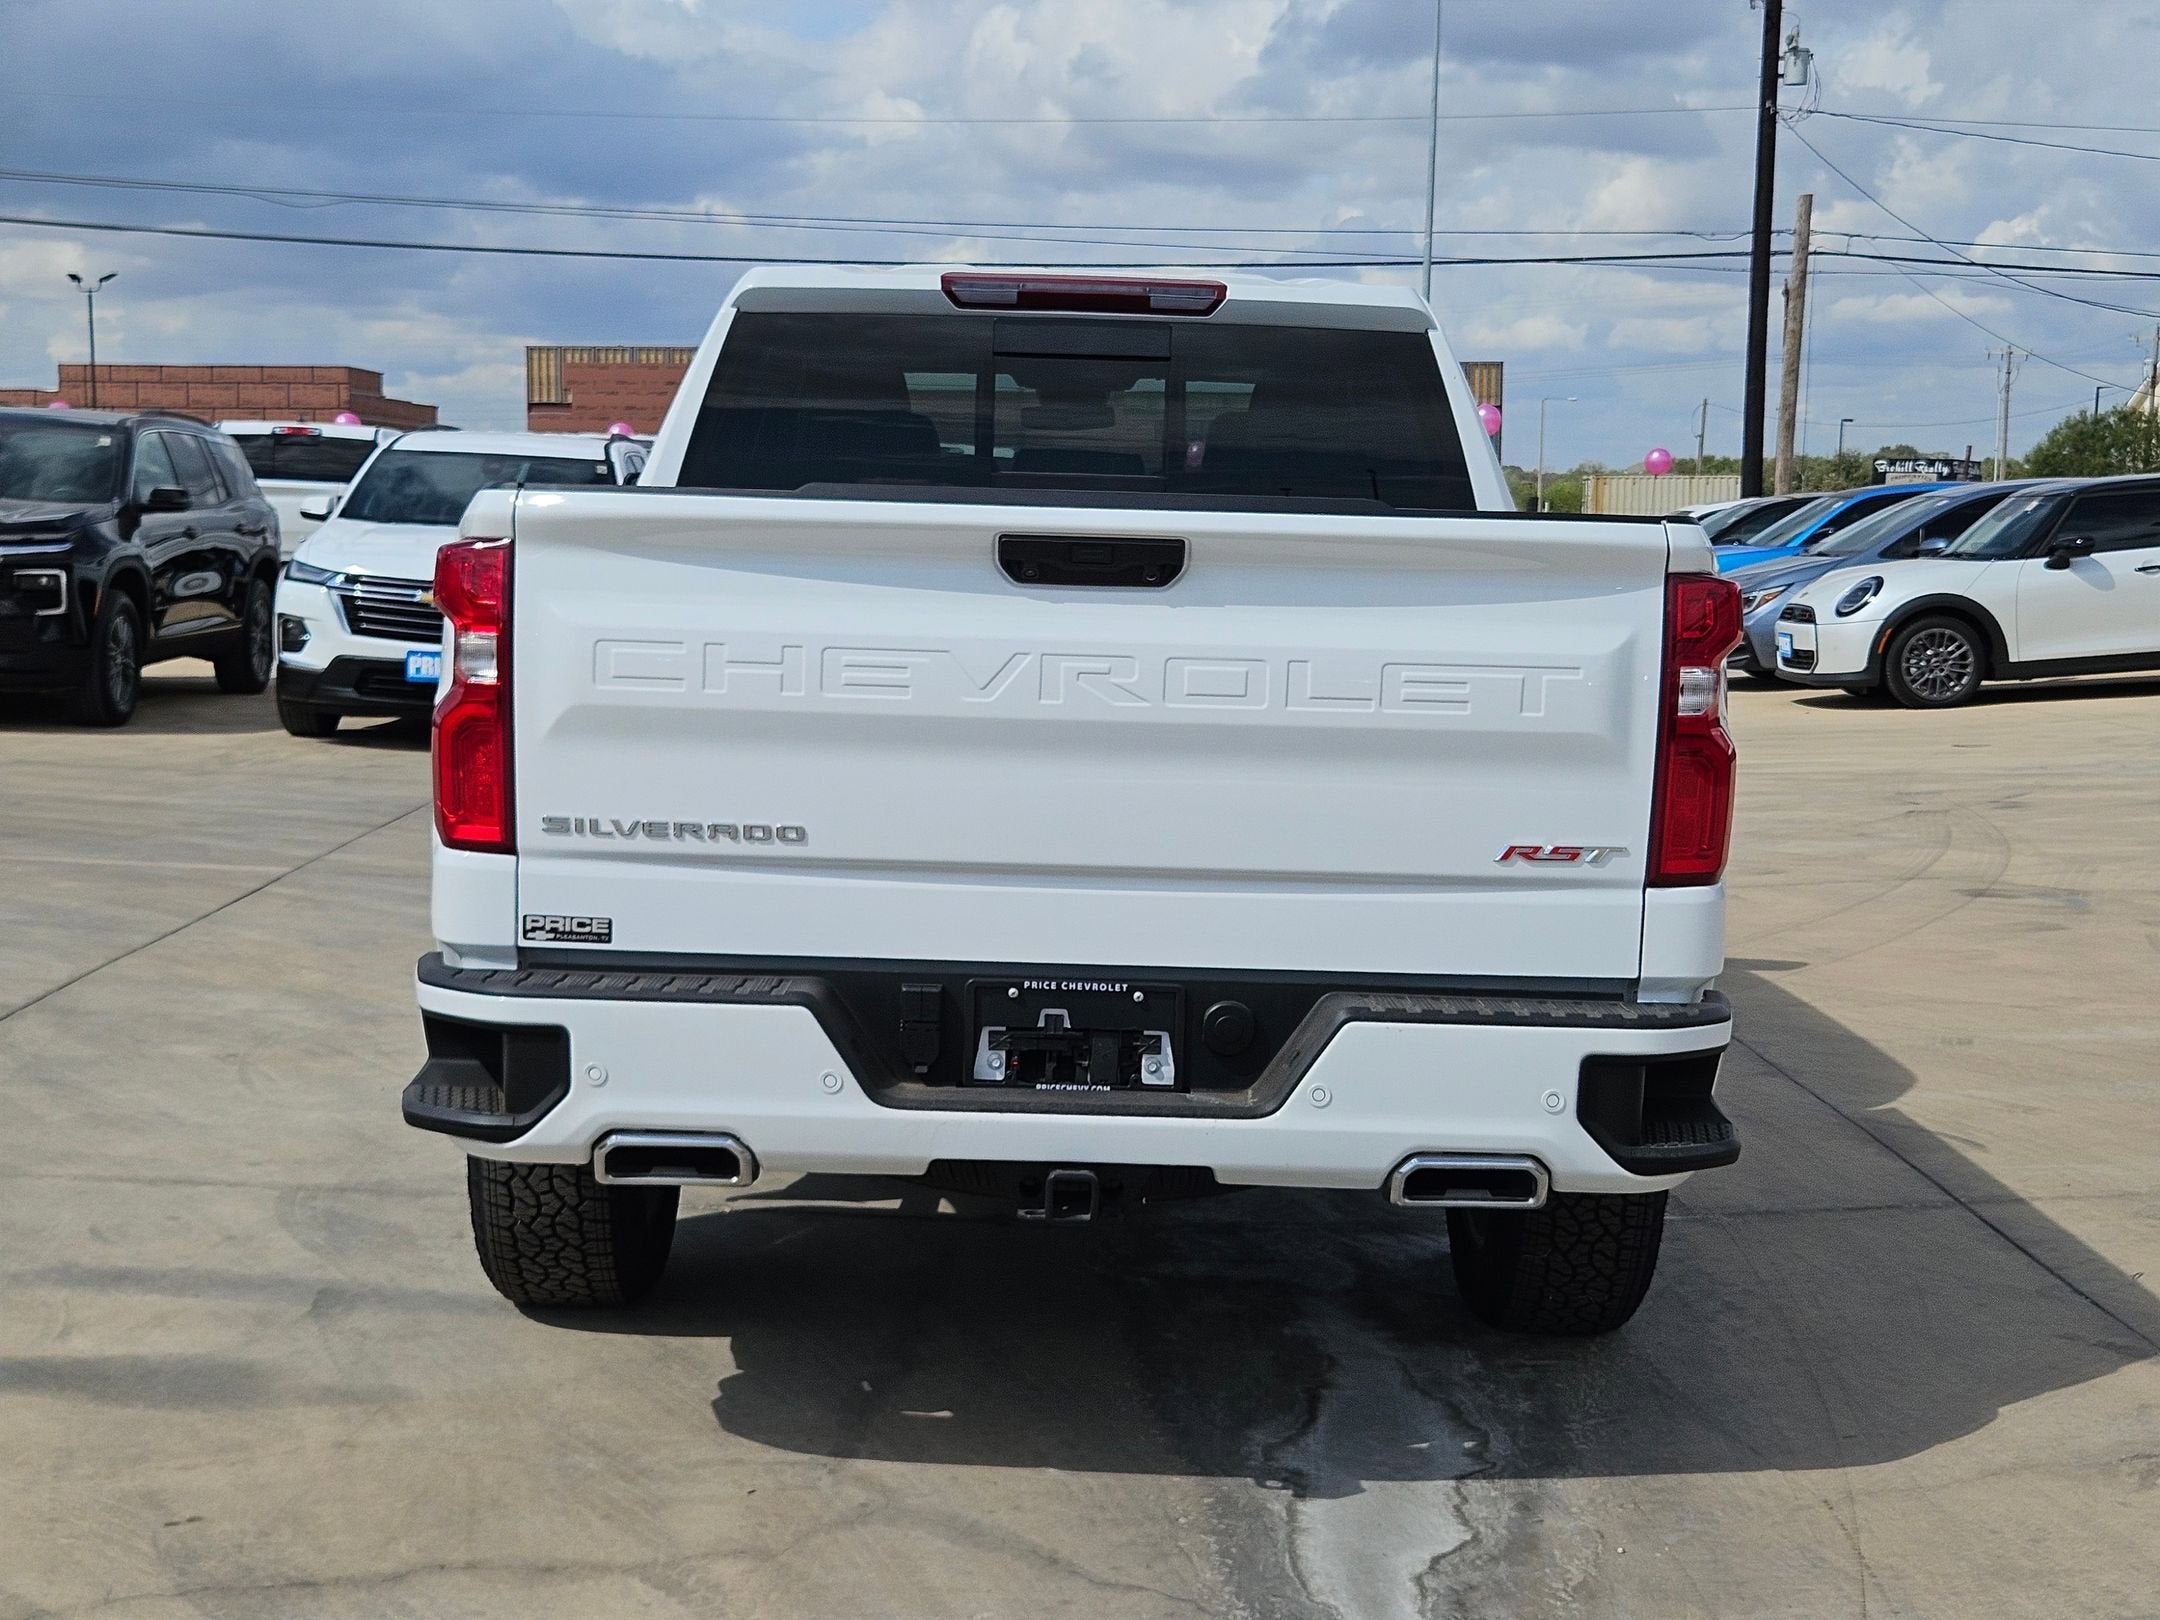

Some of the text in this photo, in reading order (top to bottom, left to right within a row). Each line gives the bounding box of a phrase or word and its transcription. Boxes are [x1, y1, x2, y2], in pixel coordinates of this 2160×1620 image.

[593, 638, 1583, 717] CHEVROLET
[541, 815, 808, 843] SILVERADO
[1493, 844, 1630, 863] RST
[525, 915, 610, 933] PRICE
[1023, 980, 1128, 992] PRICE CHEVROLET
[1035, 1083, 1111, 1092] PRICECHEVYCOM
